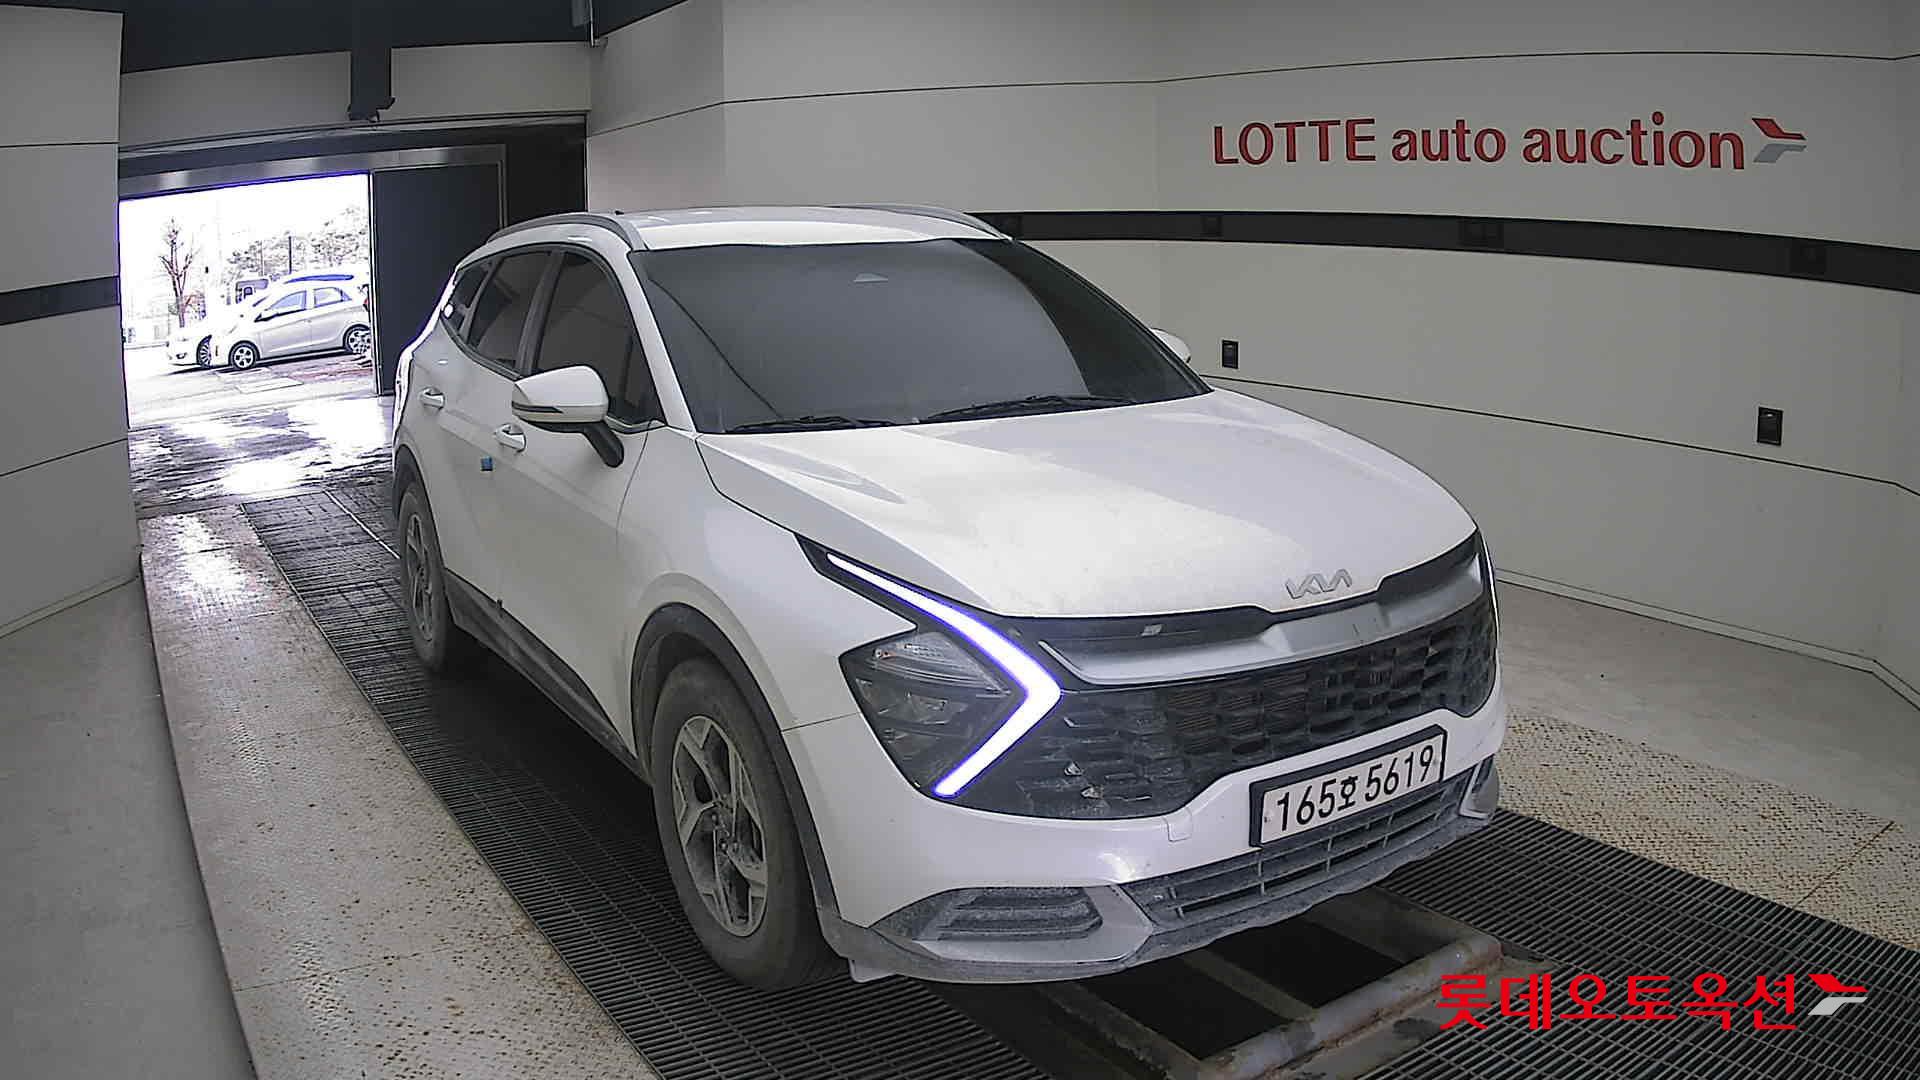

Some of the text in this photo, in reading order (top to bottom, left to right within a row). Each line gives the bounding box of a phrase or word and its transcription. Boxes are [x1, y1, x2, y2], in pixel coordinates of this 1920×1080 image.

[1213, 111, 1745, 170] LOTTE auto auction
[1285, 568, 1353, 600] KIA
[1364, 744, 1434, 802] 5619
